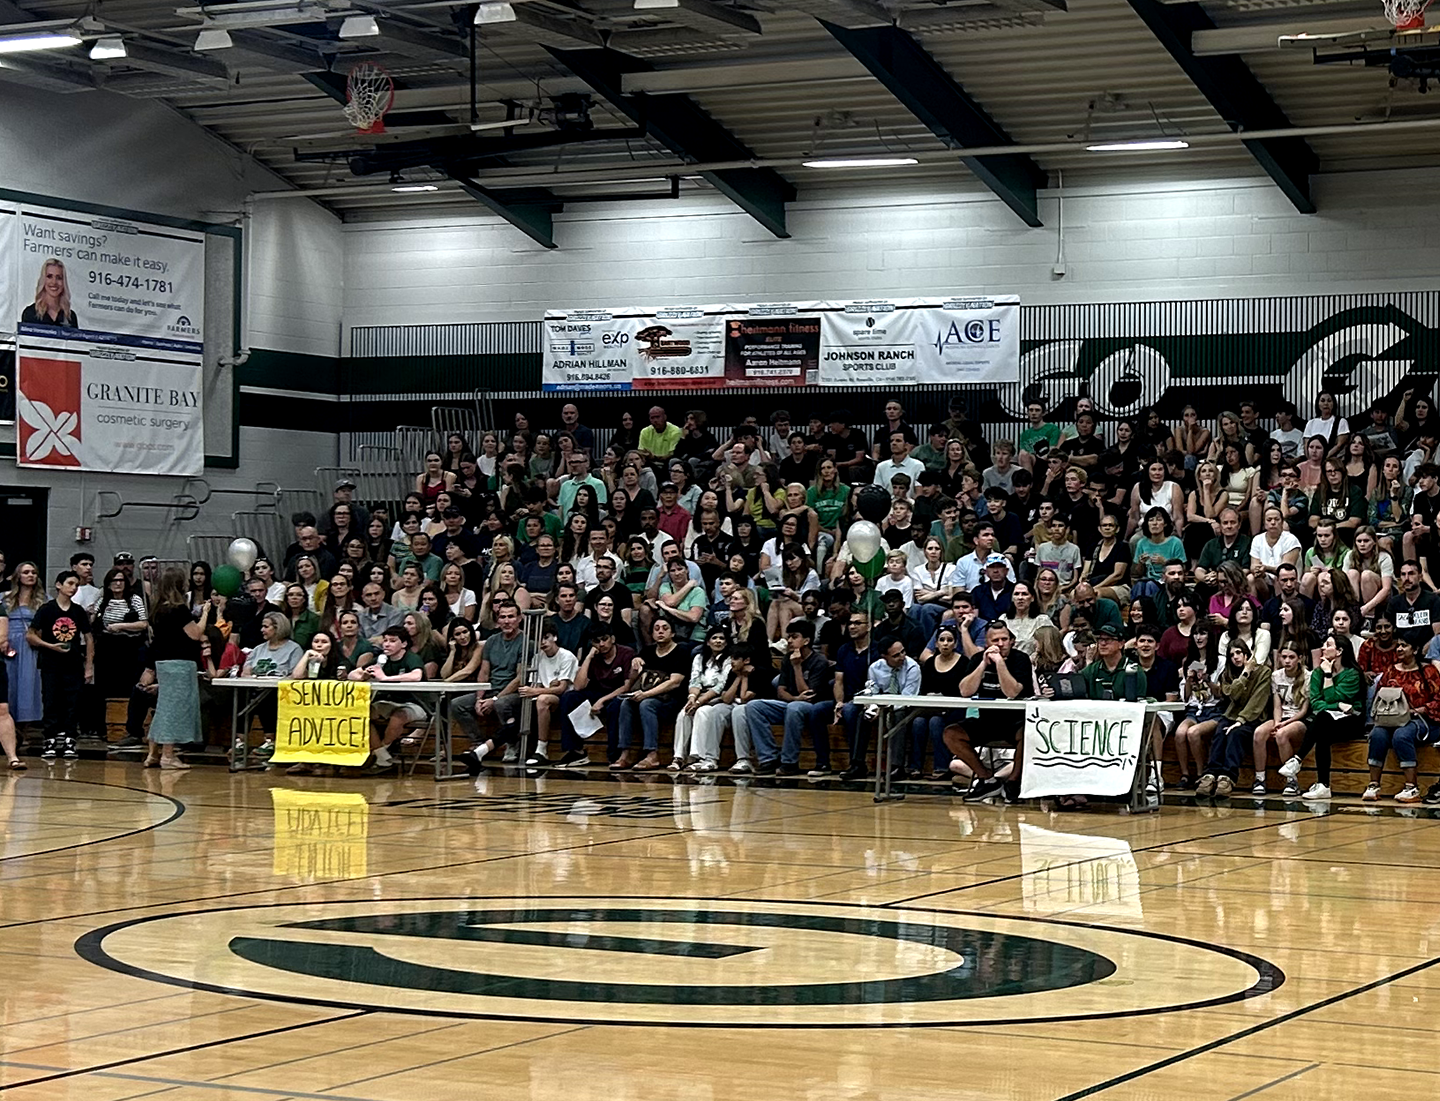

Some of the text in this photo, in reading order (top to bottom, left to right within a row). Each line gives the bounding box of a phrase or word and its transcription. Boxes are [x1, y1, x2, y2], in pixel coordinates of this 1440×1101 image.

[23, 223, 108, 249] Want savings?
[76, 248, 98, 262] can
[101, 251, 131, 266] make
[133, 256, 141, 268] it
[142, 258, 170, 273] easy.
[88, 270, 174, 293] 916-474-1781
[167, 325, 200, 335] FARMERS
[789, 322, 819, 333] fitness
[943, 319, 1001, 343] ACE
[553, 359, 627, 369] ADRIAN HILLMAN
[824, 350, 915, 361] JOHNSON RANCH
[842, 363, 897, 371] SPORTS CLUB
[87, 382, 201, 408] GRANITE BAY
[97, 413, 190, 431] cosmetic surgery
[290, 681, 355, 708] SENIOR
[288, 717, 367, 749] ADVICE!
[1035, 718, 1133, 756] SCIENCE
